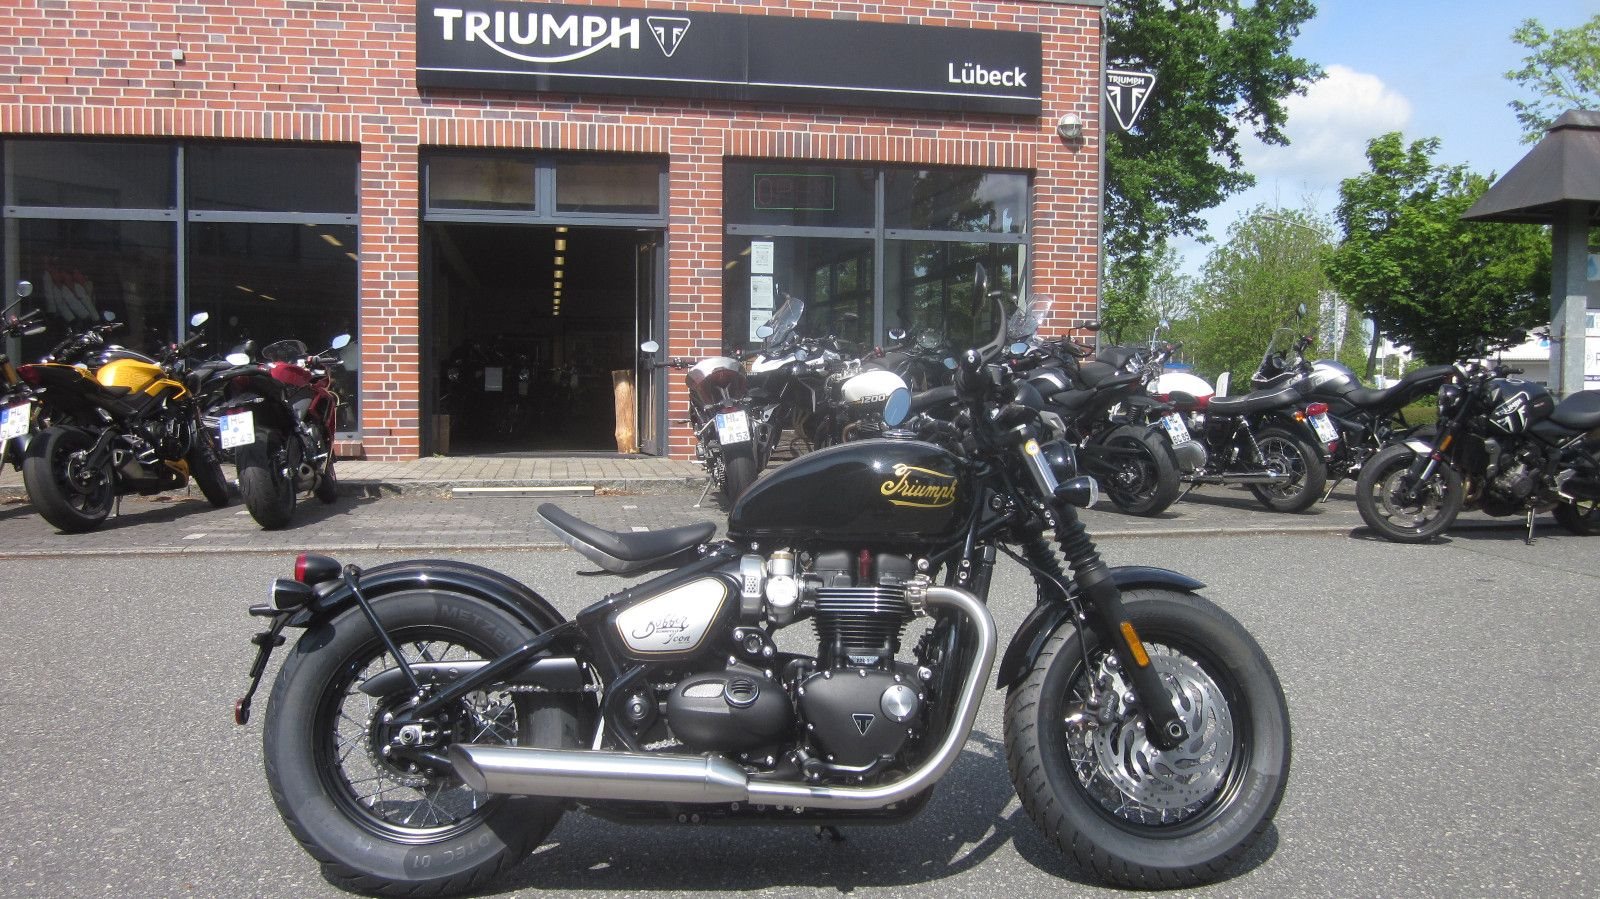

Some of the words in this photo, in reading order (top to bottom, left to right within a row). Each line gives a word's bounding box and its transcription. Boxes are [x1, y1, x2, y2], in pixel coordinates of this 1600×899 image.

[434, 8, 640, 62] TRIUMPH
[948, 62, 1027, 87] Lübeck
[1107, 75, 1145, 88] TRIUMPH
[860, 393, 887, 404] 1200
[880, 463, 958, 507] Triumph
